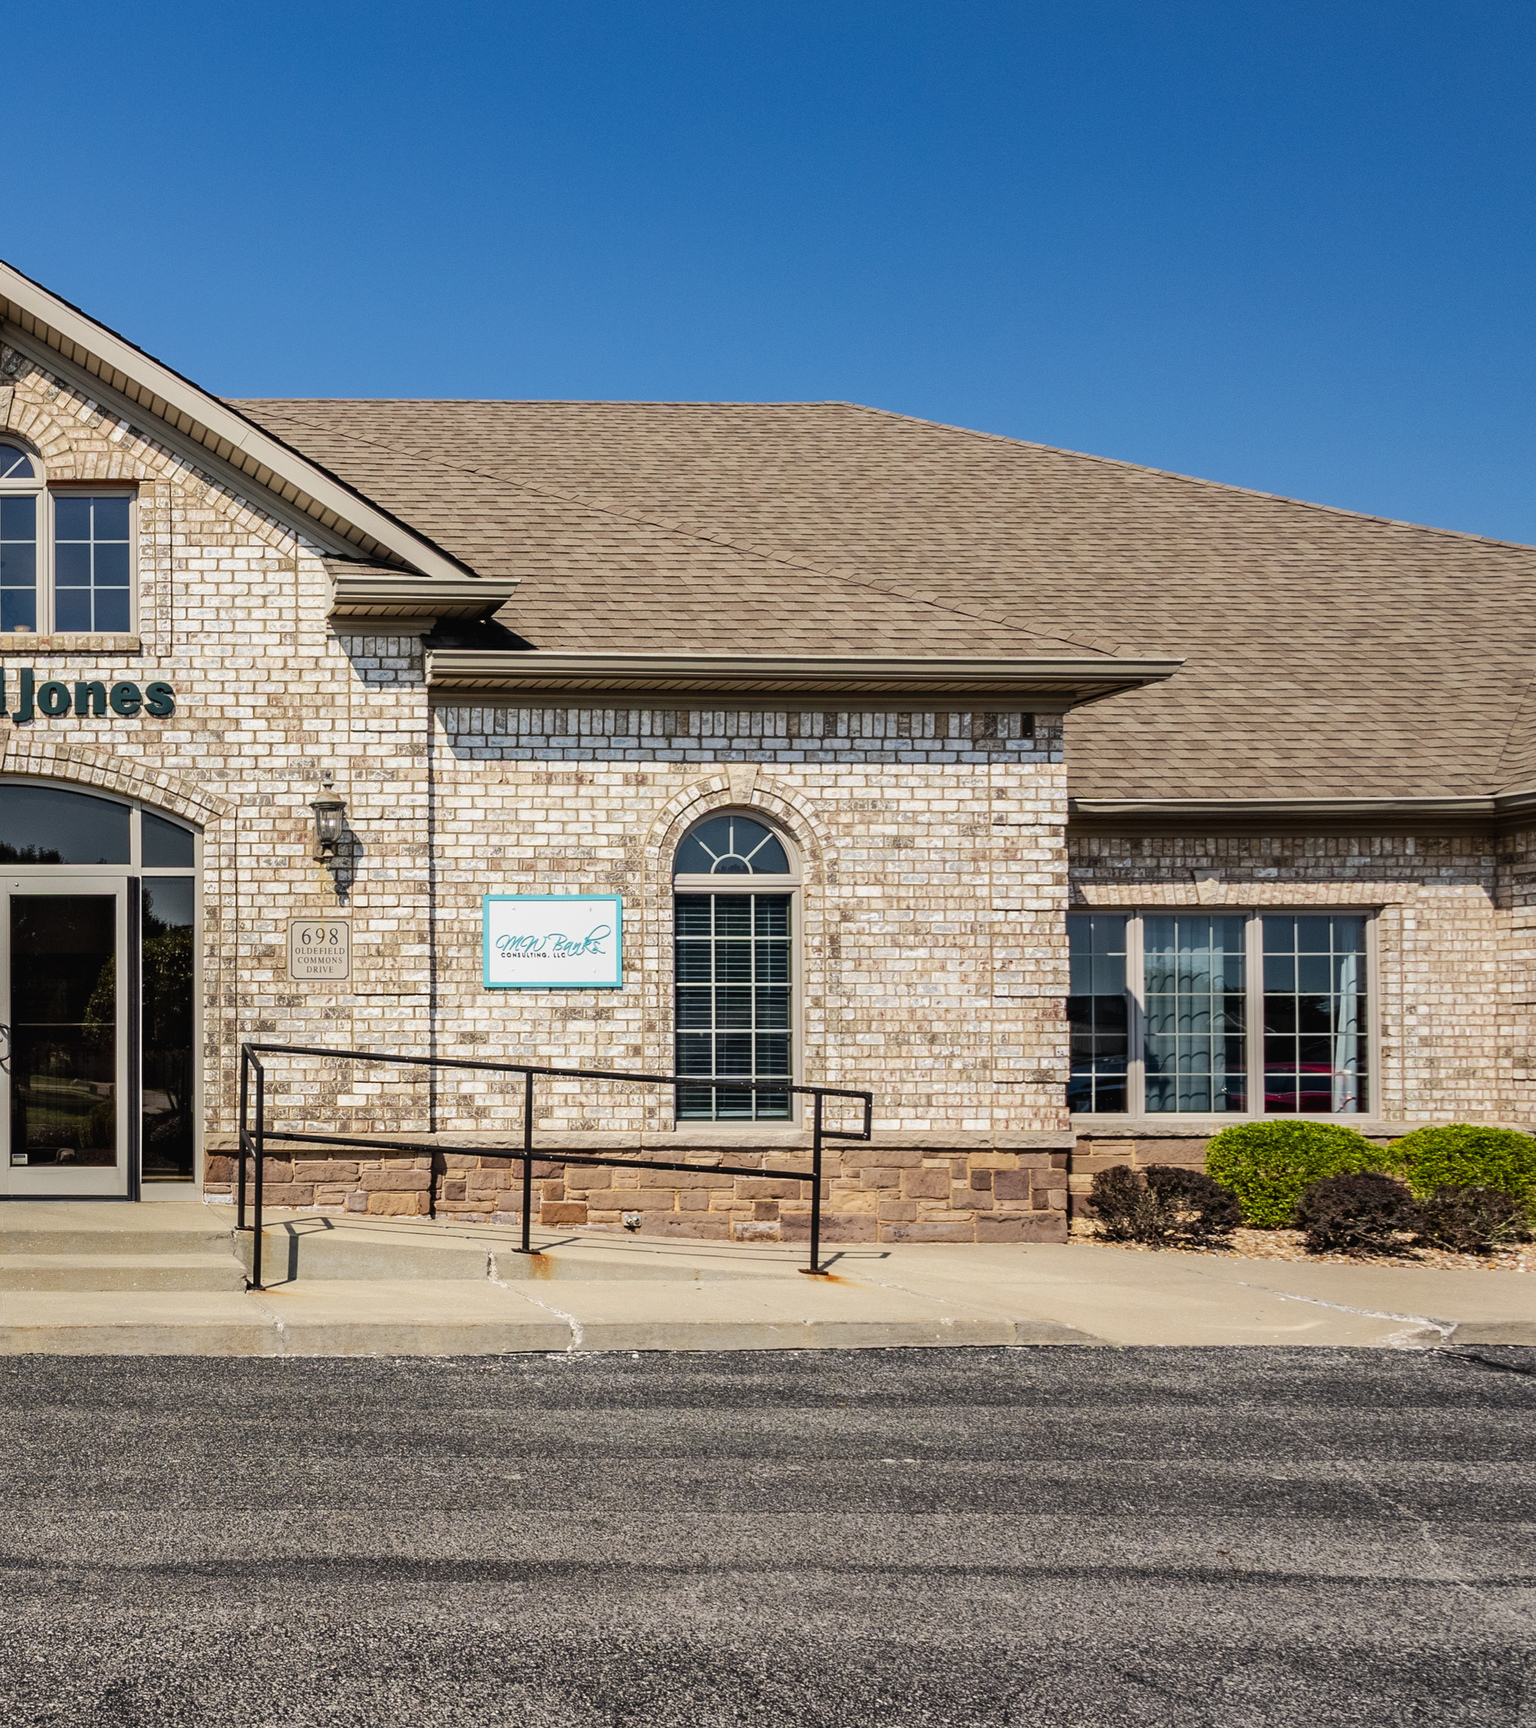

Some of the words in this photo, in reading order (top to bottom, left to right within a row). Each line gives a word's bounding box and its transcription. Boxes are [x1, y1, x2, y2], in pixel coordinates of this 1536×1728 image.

[12, 666, 177, 723] Jones
[301, 927, 339, 946] 698
[548, 924, 612, 957] Banks
[294, 947, 346, 955] OLDEFIELD
[297, 956, 343, 964] COMMONS
[306, 965, 334, 974] DRIVE
